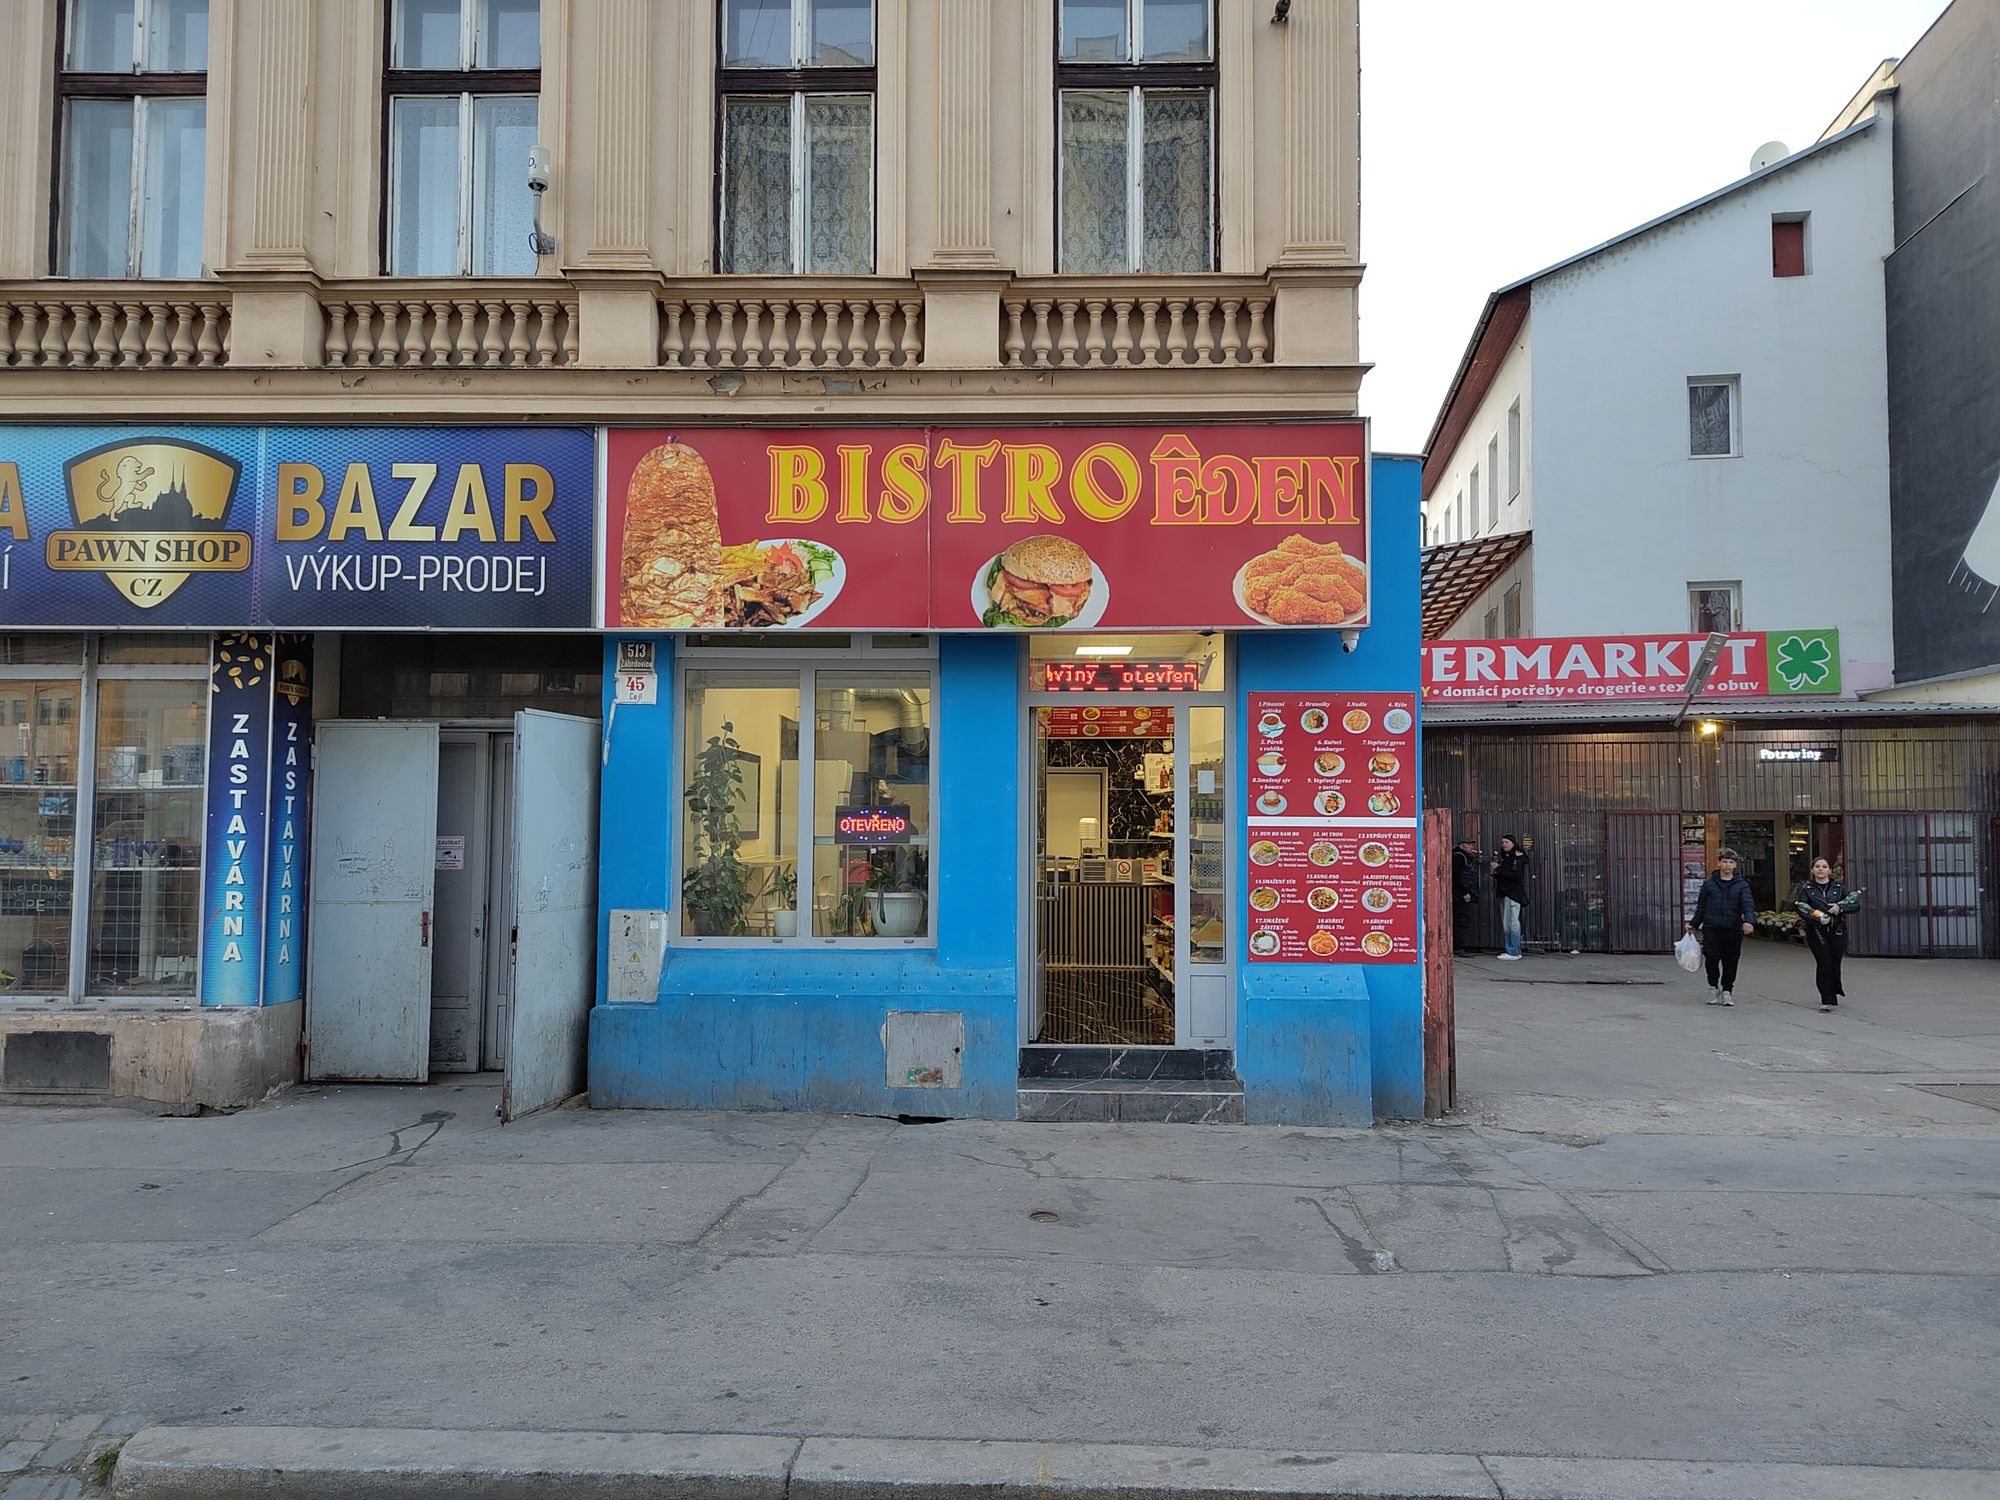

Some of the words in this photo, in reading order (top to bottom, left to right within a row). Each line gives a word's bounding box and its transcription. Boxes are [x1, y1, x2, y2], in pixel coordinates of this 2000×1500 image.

[765, 438, 1142, 524] BISTRO
[1150, 433, 1361, 525] ÊDEN
[275, 462, 559, 543] BAZAR
[55, 538, 149, 563] PAWN
[154, 538, 242, 563] SHOP
[285, 546, 547, 597] VÝKUP-PRODEJ
[129, 578, 163, 597] CZ
[627, 643, 646, 658] 513
[626, 676, 645, 691] 45
[1443, 684, 1498, 697] domácí
[1501, 683, 1564, 699] potřeby
[1577, 681, 1646, 697] drogerie
[1717, 679, 1760, 691] obuv
[629, 692, 643, 702] Cejl
[1760, 748, 1822, 761] Potraviny
[840, 814, 906, 831] OTEVŘENO
[222, 713, 251, 962] ZASTAVÁRNA
[278, 721, 298, 965] ZASTAVÁRNA
